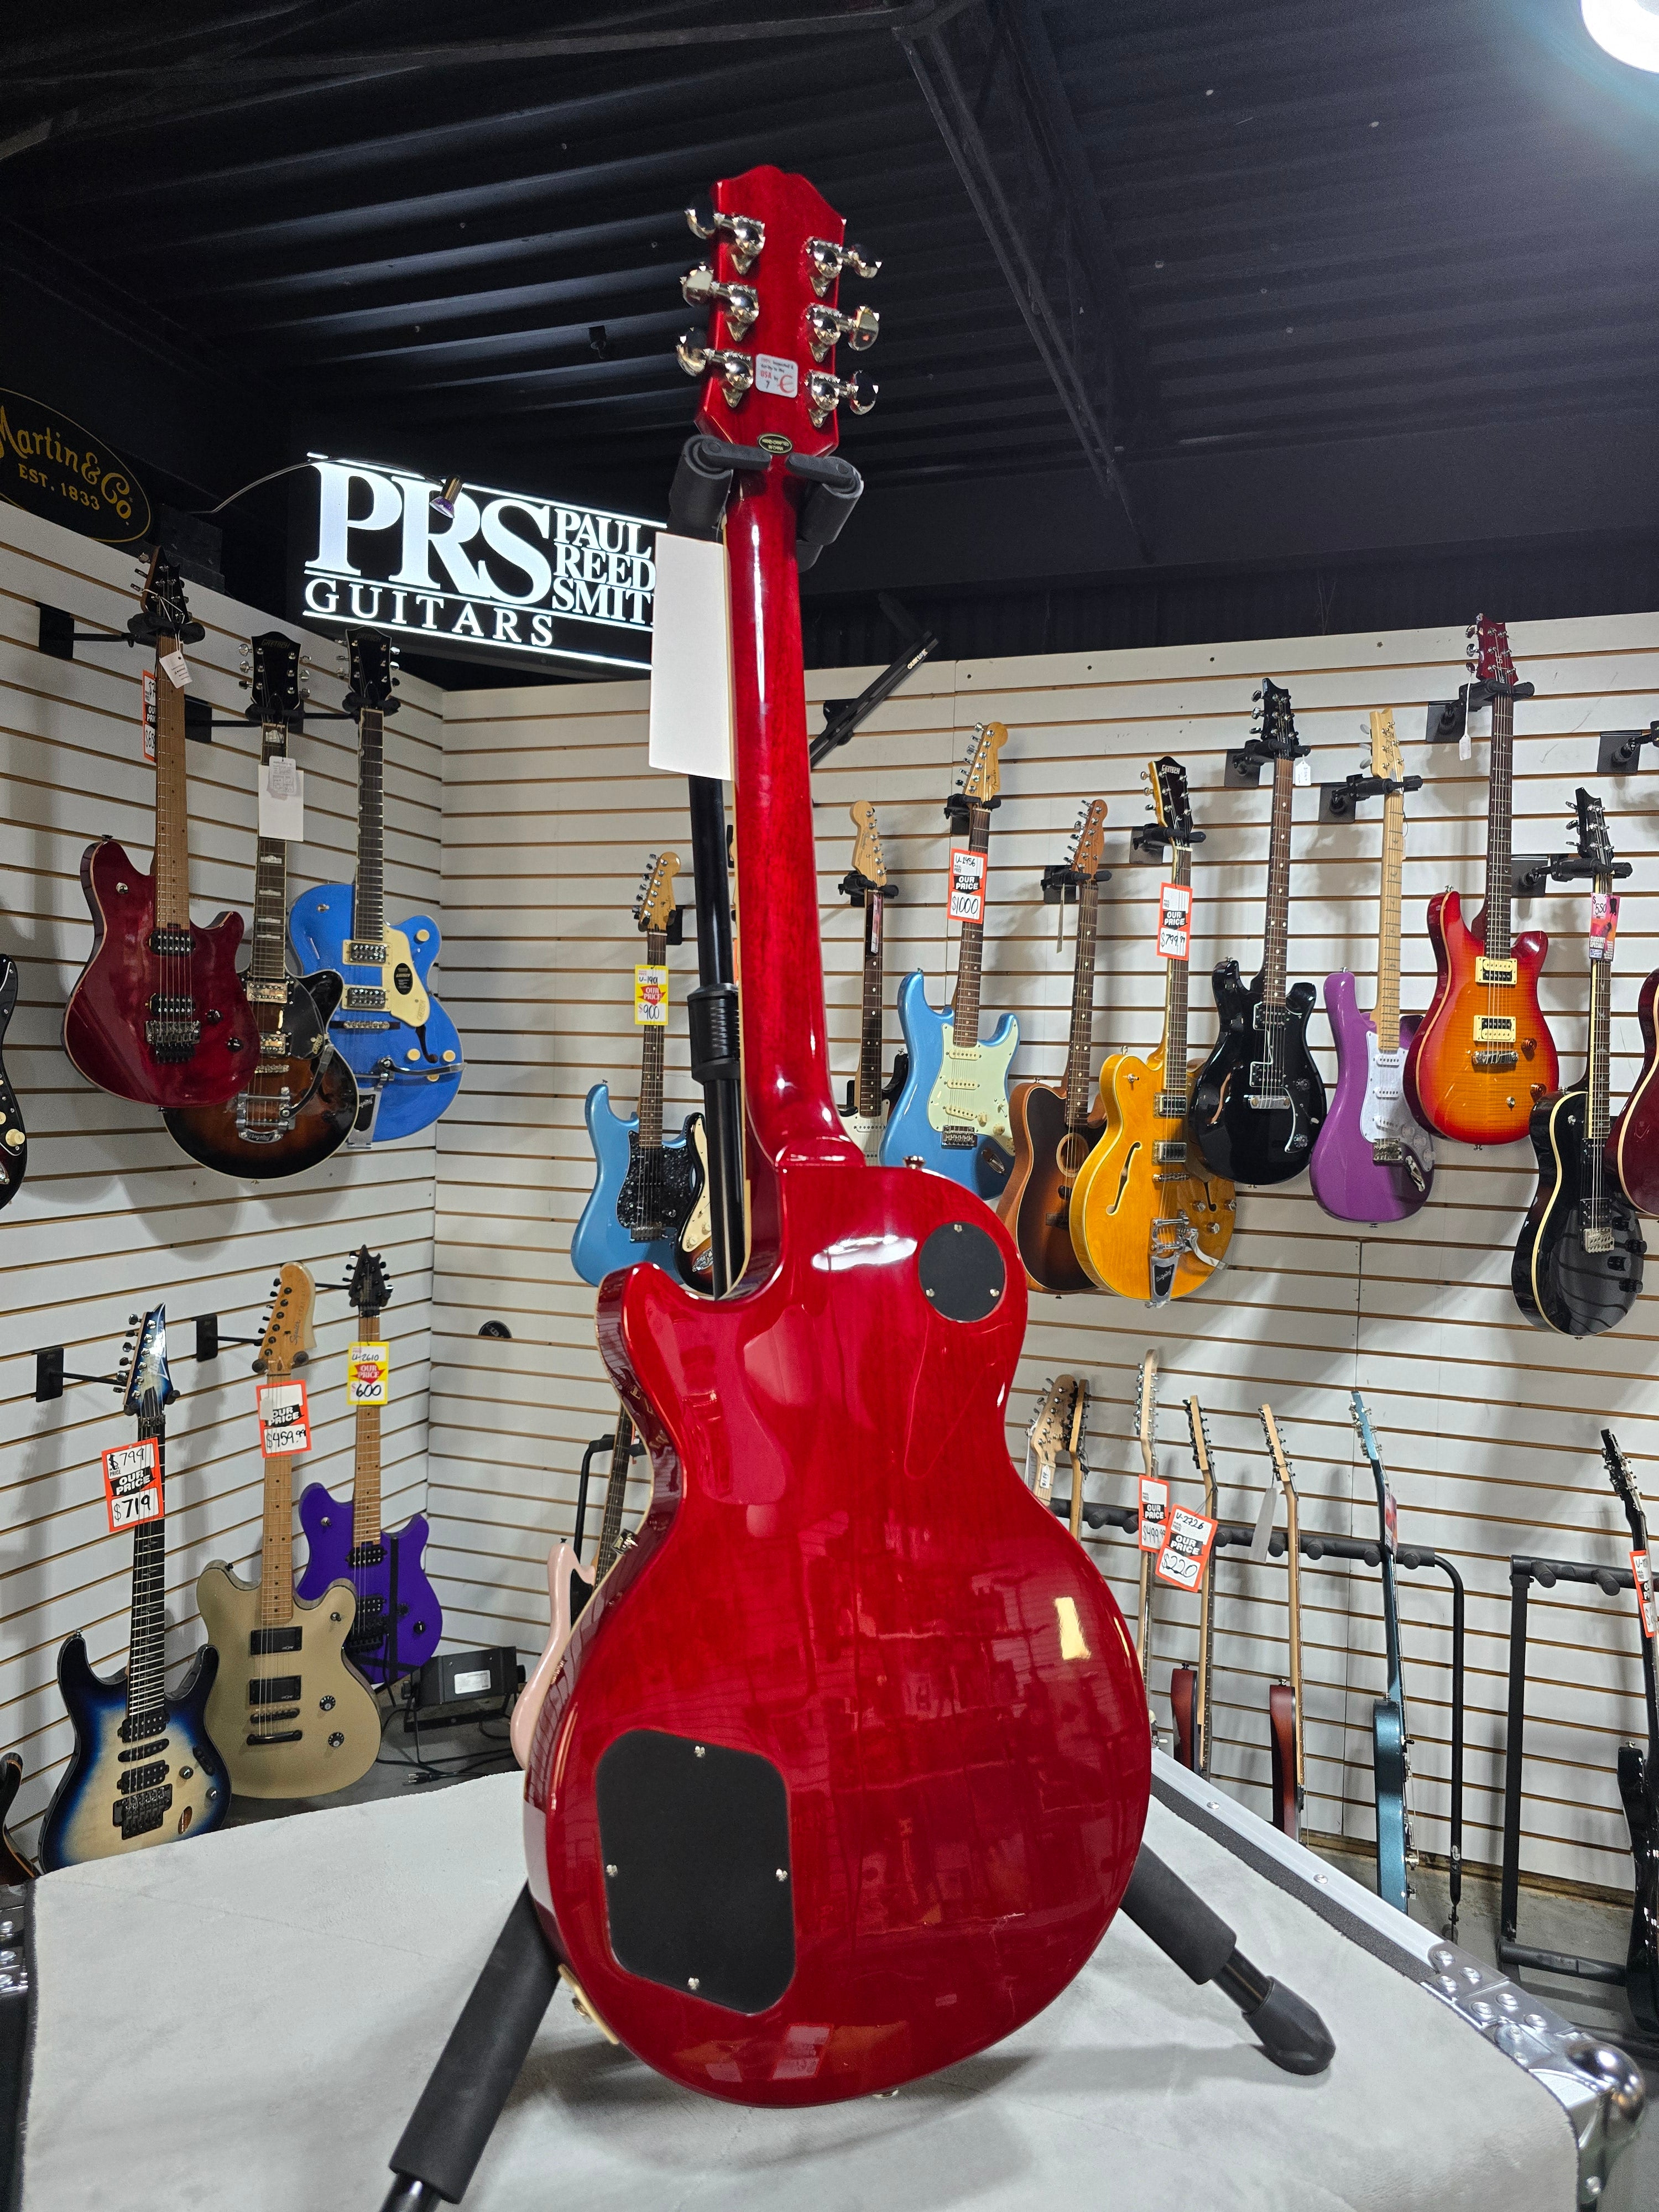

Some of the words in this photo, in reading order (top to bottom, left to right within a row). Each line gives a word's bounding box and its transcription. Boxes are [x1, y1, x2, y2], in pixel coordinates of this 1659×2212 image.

[760, 370, 772, 378] USA
[61, 482, 100, 510] 1833
[304, 461, 552, 606] PRS
[554, 507, 653, 560] PAUL
[554, 541, 656, 592] REED
[552, 576, 654, 626] SMIT
[304, 577, 553, 647] GUITARS
[951, 895, 979, 915] $1000
[1164, 918, 1186, 926] PRICE
[1166, 911, 1182, 919] OUR
[638, 1004, 660, 1020] $900
[357, 1370, 380, 1379] PRICE
[351, 1383, 382, 1398] $600
[268, 1411, 300, 1427] PRICE
[273, 1406, 294, 1417] OUR
[109, 1469, 122, 1477] PRICE
[118, 1469, 144, 1486] OUR
[116, 1474, 151, 1496] PRICE
[113, 1494, 152, 1522] $719
[1144, 1510, 1165, 1520] PRICE
[1146, 1504, 1162, 1512] OUR
[1170, 1540, 1201, 1556] PRICE
[1175, 1534, 1198, 1548] OUR
[1161, 1553, 1198, 1578] $220
